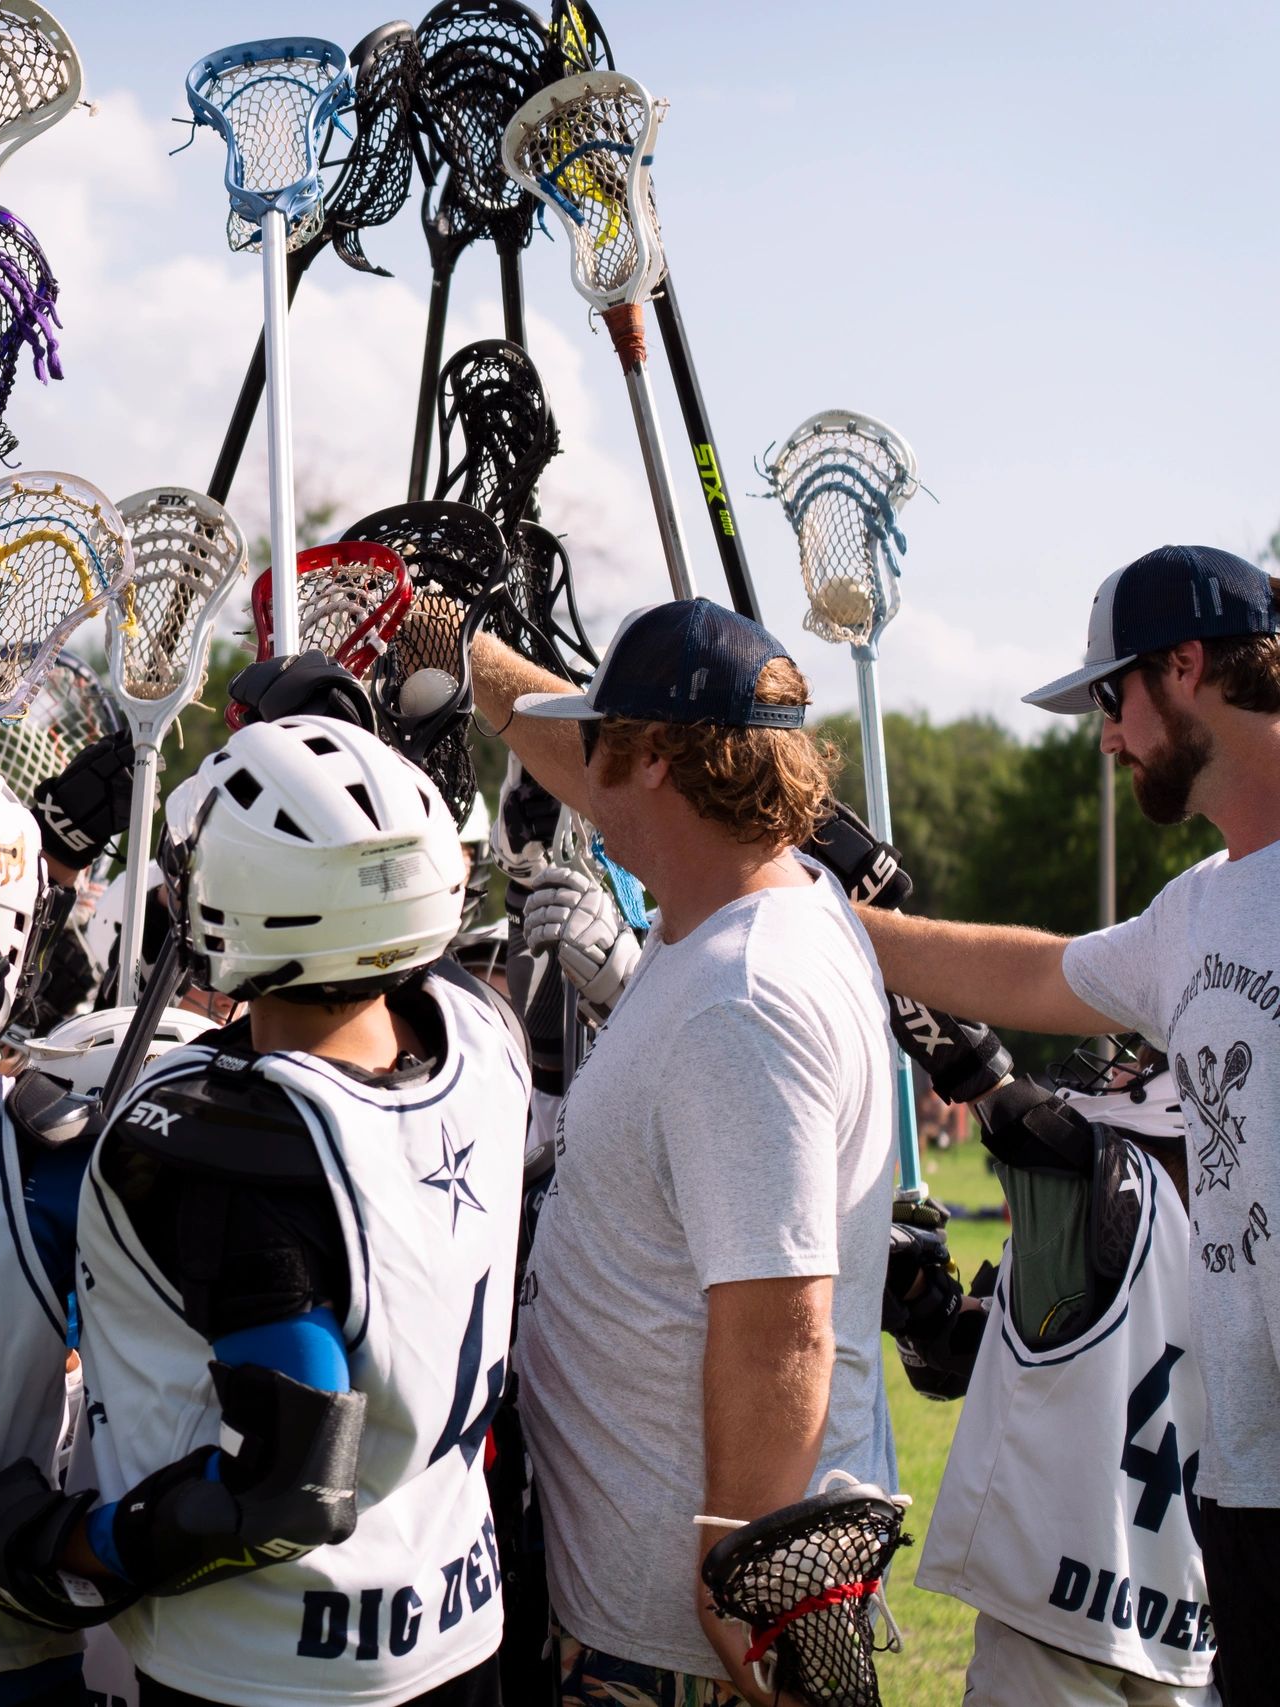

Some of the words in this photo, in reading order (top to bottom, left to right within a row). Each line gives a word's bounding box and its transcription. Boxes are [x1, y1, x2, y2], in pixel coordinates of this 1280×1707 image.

[503, 348, 524, 367] STX
[158, 494, 188, 506] STX
[693, 443, 726, 505] STX
[719, 509, 735, 536] 6000
[37, 792, 96, 852] STX
[893, 993, 954, 1056] STX
[126, 1101, 182, 1137] STX
[947, 1295, 958, 1316] LEFT
[297, 1586, 422, 1660] DIG
[439, 1512, 502, 1634] DEE
[1048, 1556, 1132, 1630] DIG
[1137, 1586, 1218, 1653] DEE
